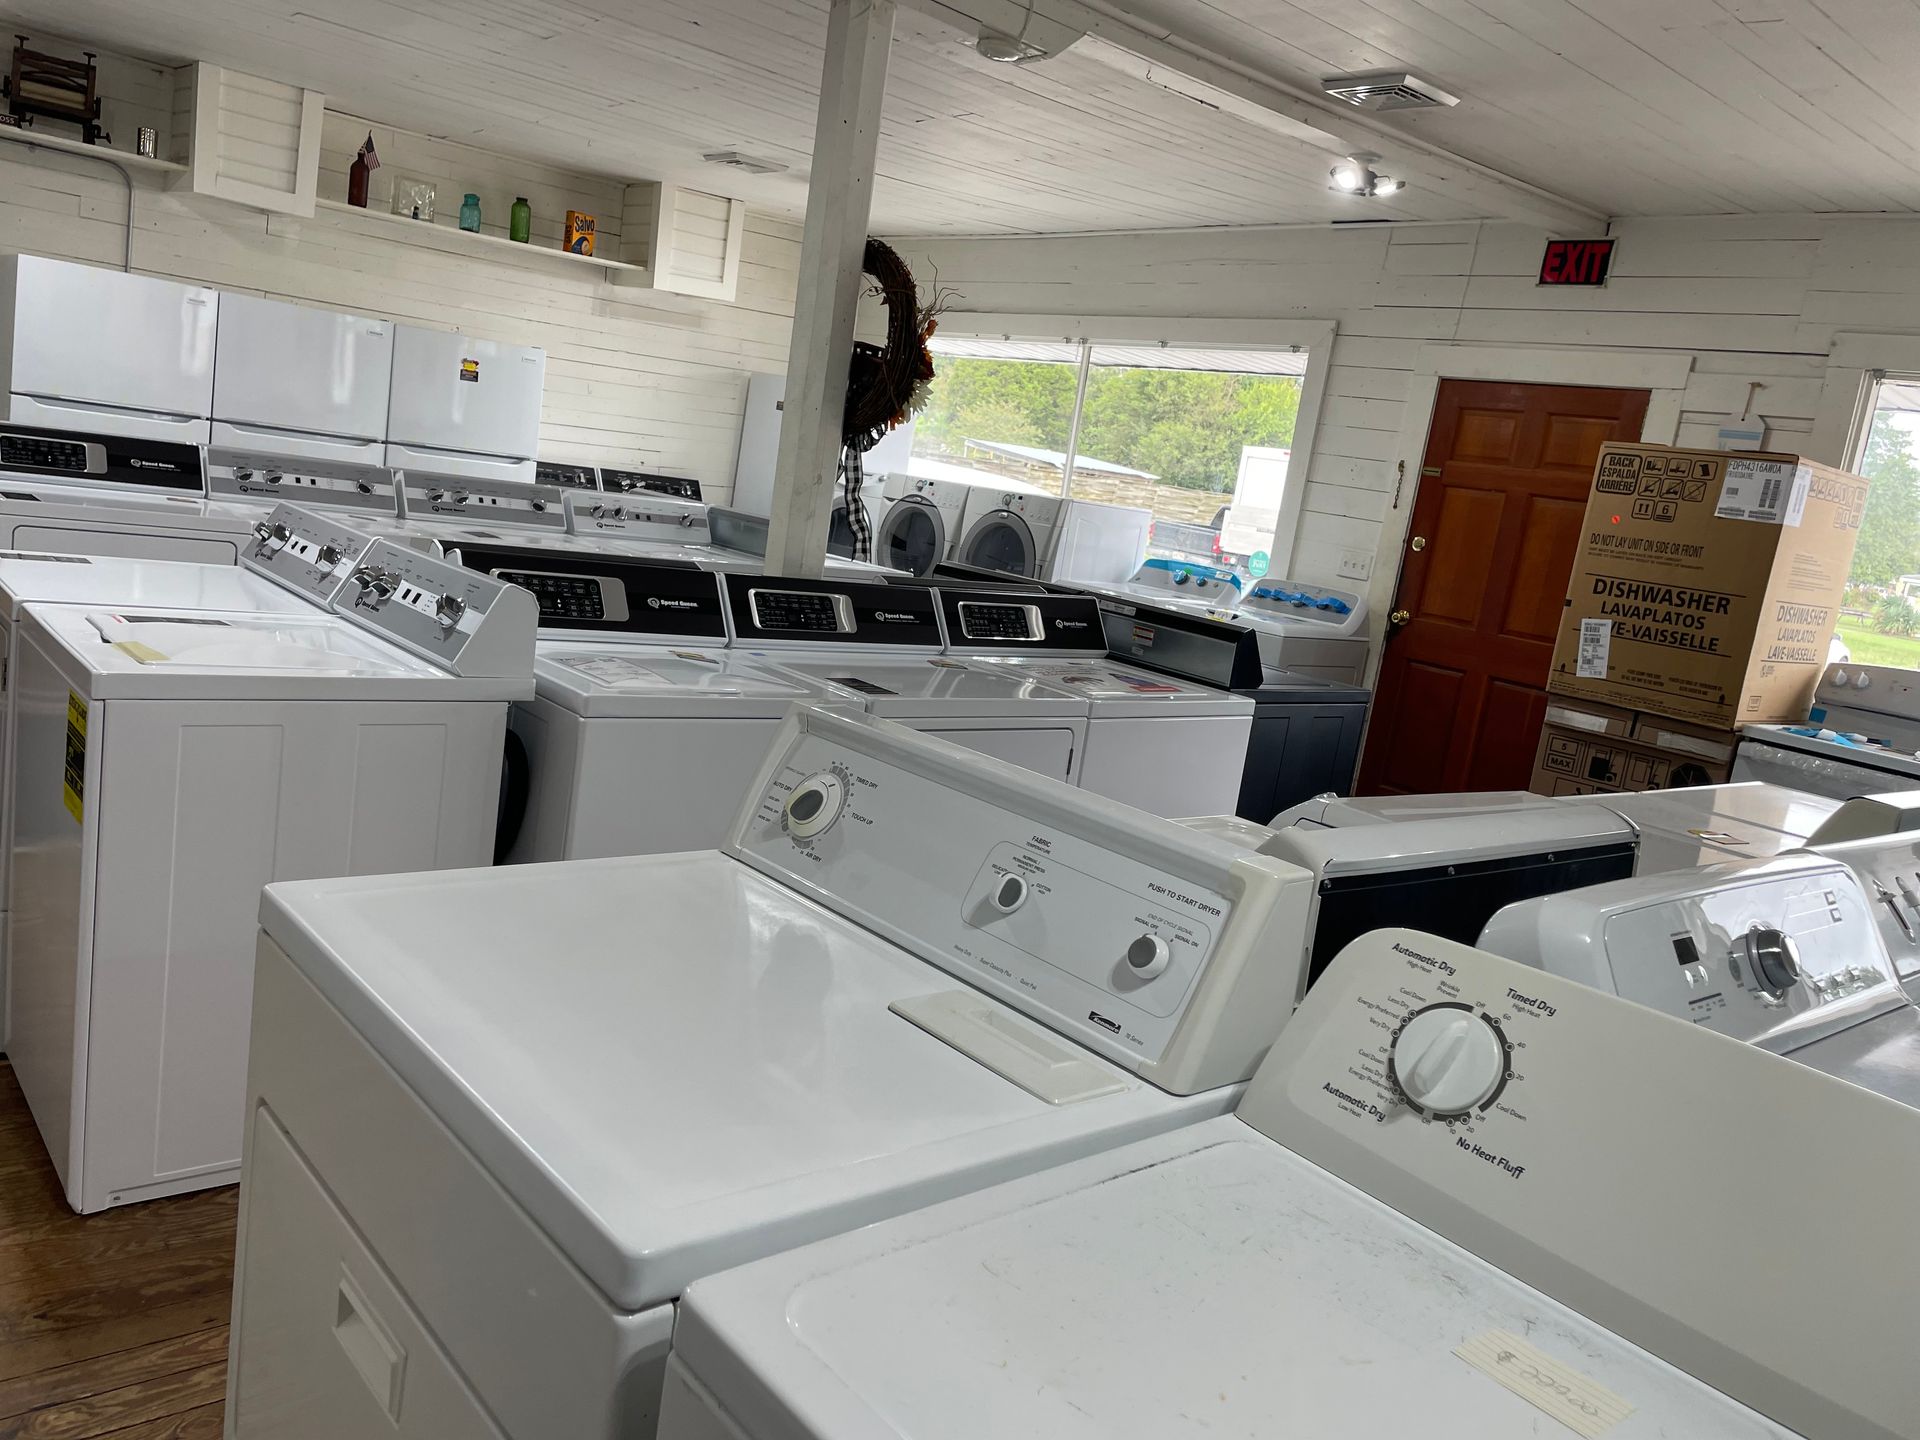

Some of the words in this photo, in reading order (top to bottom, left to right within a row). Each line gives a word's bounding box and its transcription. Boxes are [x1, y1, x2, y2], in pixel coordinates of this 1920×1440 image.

[575, 215, 595, 232] Salvo
[1544, 242, 1611, 283] EXIT
[1609, 455, 1635, 469] BACK
[1601, 467, 1637, 481] ESPALDA
[1662, 504, 1669, 515] 6
[1590, 533, 1600, 545] DO
[1601, 534, 1615, 548] NOT
[1615, 536, 1628, 549] LAY
[1628, 538, 1644, 551] UNIT
[1644, 540, 1654, 552] ON
[1655, 541, 1669, 554] SIDE
[1670, 543, 1680, 555] OR
[1681, 545, 1704, 559] FRONT
[1592, 577, 1731, 615] DISHWASHER
[1600, 600, 1706, 630] LAVAPLATOS
[1776, 605, 1828, 627] DISHWASHER
[1777, 627, 1816, 644] LAVAPLATOS
[1767, 645, 1817, 662] LAVE-VAISSELLE
[1550, 758, 1571, 769] MAX
[773, 780, 784, 790] AUTO
[784, 784, 792, 792] DRY
[868, 781, 878, 789] DRY
[851, 812, 866, 823] TOUCH
[1032, 835, 1052, 848] FABRIC
[805, 851, 813, 859] AIR
[812, 854, 822, 862] DRY
[1147, 882, 1166, 895] PUSH
[1166, 889, 1176, 899] TO
[1176, 894, 1198, 907] START
[1198, 902, 1221, 917] DRYER
[1134, 916, 1149, 927] SIGNAL
[1163, 919, 1177, 930] CYCLE
[1177, 925, 1194, 936] SIGNAL
[1174, 934, 1190, 945] SIGNAL
[1190, 940, 1199, 948] ON
[1391, 943, 1439, 968] Automatic
[1438, 961, 1457, 977] Dry
[1406, 960, 1420, 969] High
[1419, 965, 1432, 974] Heat
[1437, 985, 1458, 999] Prevent
[1440, 980, 1460, 993] Wrinkle
[1387, 995, 1401, 1006] Less
[1400, 1001, 1410, 1010] Dry
[1400, 987, 1413, 998] Cool
[1412, 992, 1427, 1003] Down
[1506, 987, 1539, 1007] Timed
[1537, 1000, 1557, 1017] Dry
[1357, 996, 1376, 1009] Energy
[1375, 1003, 1401, 1020] Preferred
[1475, 1001, 1486, 1009] Off
[1511, 1003, 1525, 1013] High
[1526, 1007, 1541, 1018] Heat
[1369, 1017, 1380, 1028] Very
[1380, 1021, 1391, 1032] Dry
[1502, 1013, 1512, 1021] 60
[1093, 1016, 1120, 1034] Kenmore
[1517, 1041, 1527, 1049] 40
[1358, 1048, 1371, 1059] Cool
[1370, 1054, 1385, 1065] Down
[1361, 1063, 1375, 1074] Less
[1374, 1069, 1384, 1079] Dry
[1515, 1074, 1524, 1082] 20
[1348, 1066, 1367, 1081] Energy
[1366, 1075, 1392, 1092] Preferred
[1322, 1082, 1369, 1112] Automatic
[1368, 1105, 1386, 1123] Dry
[1377, 1091, 1388, 1104] Very
[1388, 1098, 1399, 1109] Dry
[1337, 1102, 1349, 1112] Low
[1349, 1107, 1362, 1119] Heat
[1475, 1113, 1487, 1123] Off
[1496, 1102, 1509, 1114] Cool
[1508, 1108, 1527, 1122] Down
[1420, 1116, 1432, 1126] Off
[1466, 1126, 1475, 1134] 20
[1456, 1136, 1471, 1151] No
[1471, 1144, 1497, 1164] Heat
[1497, 1157, 1526, 1180] Fluff
